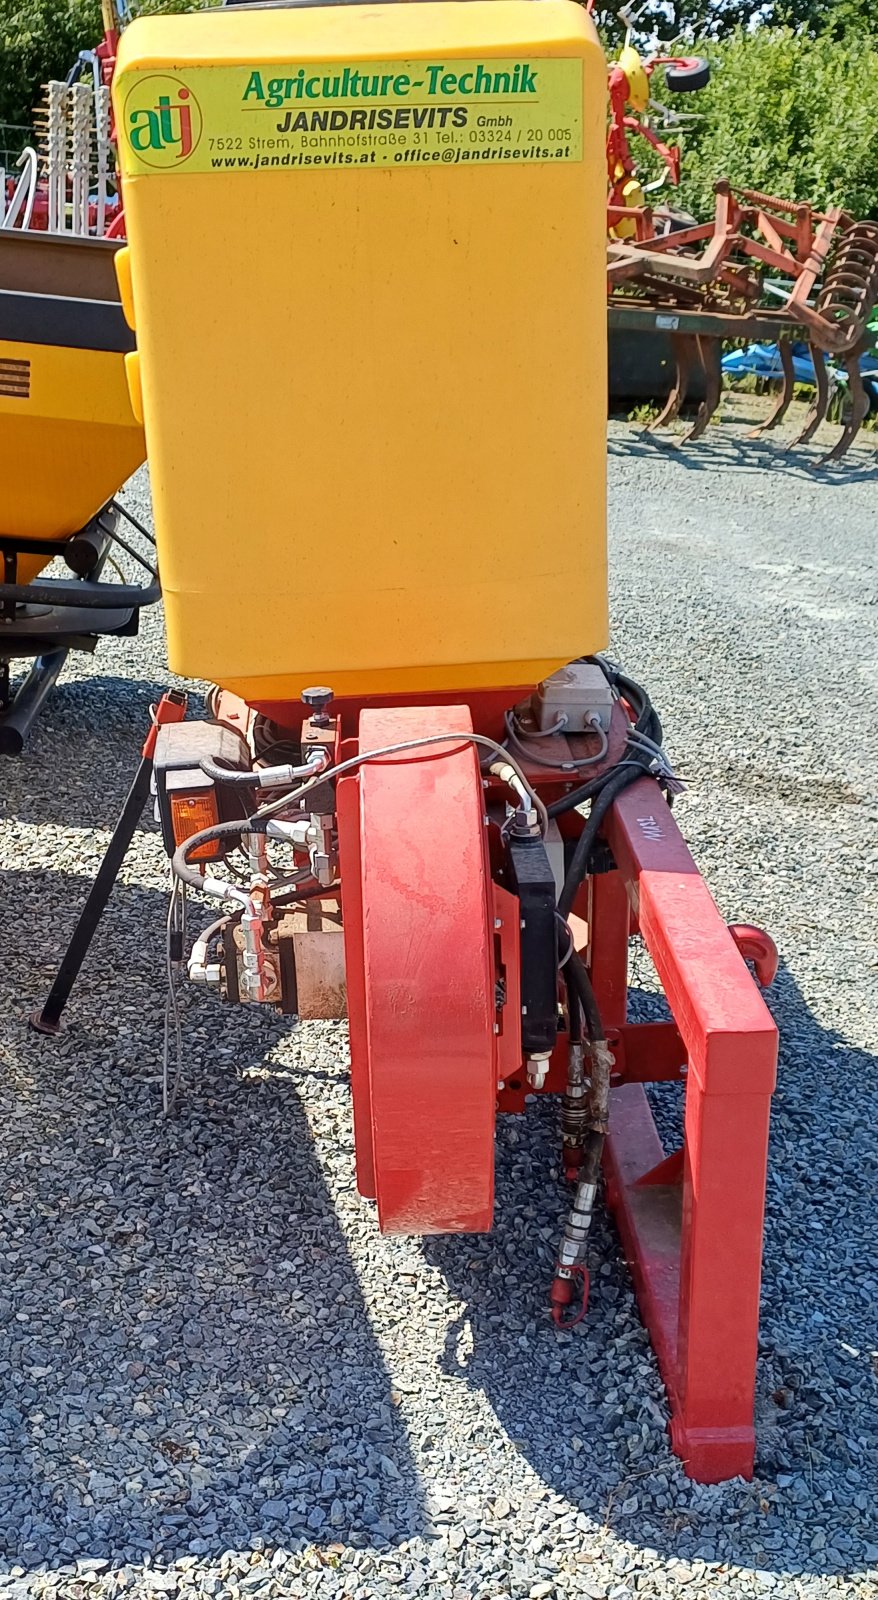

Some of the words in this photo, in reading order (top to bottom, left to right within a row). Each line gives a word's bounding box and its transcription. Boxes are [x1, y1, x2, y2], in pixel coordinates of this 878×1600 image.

[242, 64, 538, 107] Agriculture-Technik
[276, 107, 468, 132] JANDRISEVITS
[476, 115, 513, 128] Gmbh
[208, 138, 243, 151] 7522
[249, 136, 295, 151] Strem,
[301, 132, 407, 148] Bahnhofstraße
[413, 132, 428, 144] 31
[436, 131, 464, 144] Tel.:
[470, 130, 512, 143] 03324
[527, 129, 543, 142] 20
[547, 128, 572, 141] 005
[211, 151, 376, 169] www.jandrisevits.at
[394, 146, 570, 164] office@jandrisevits.at
